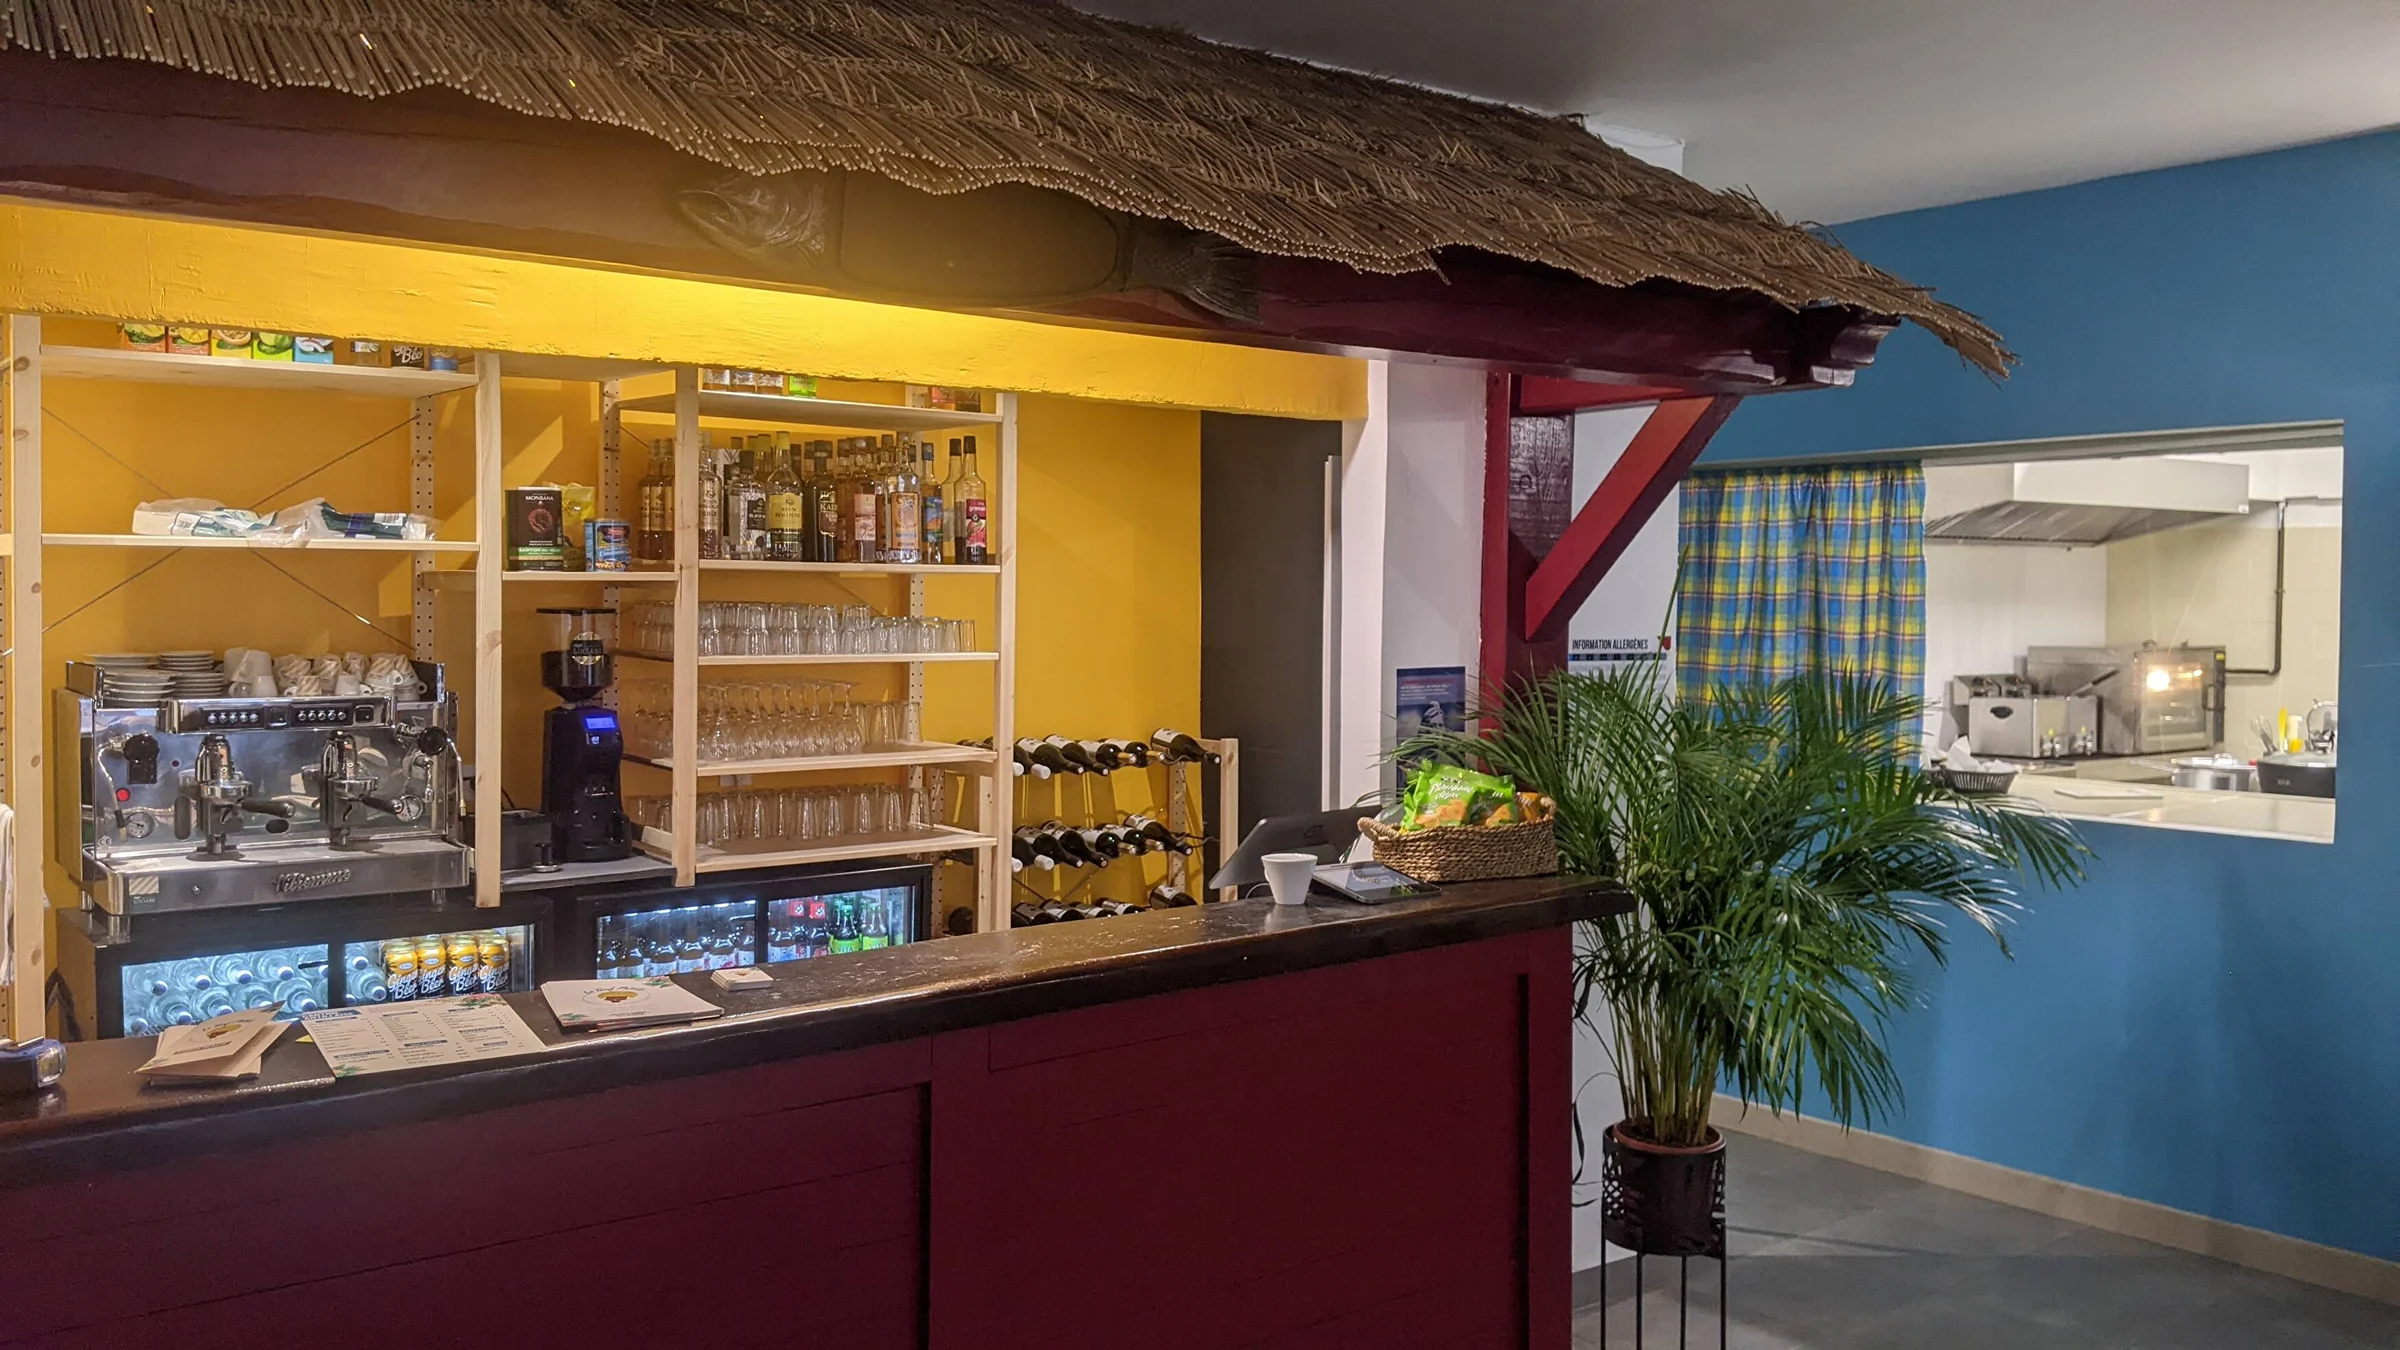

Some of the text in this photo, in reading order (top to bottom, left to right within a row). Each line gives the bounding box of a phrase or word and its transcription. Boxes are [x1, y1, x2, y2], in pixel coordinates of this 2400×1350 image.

[1572, 637, 1649, 650] INFORMATION ALLERGÈNES
[394, 983, 417, 1000] Beer
[421, 979, 444, 994] Beer
[455, 975, 478, 992] Beer
